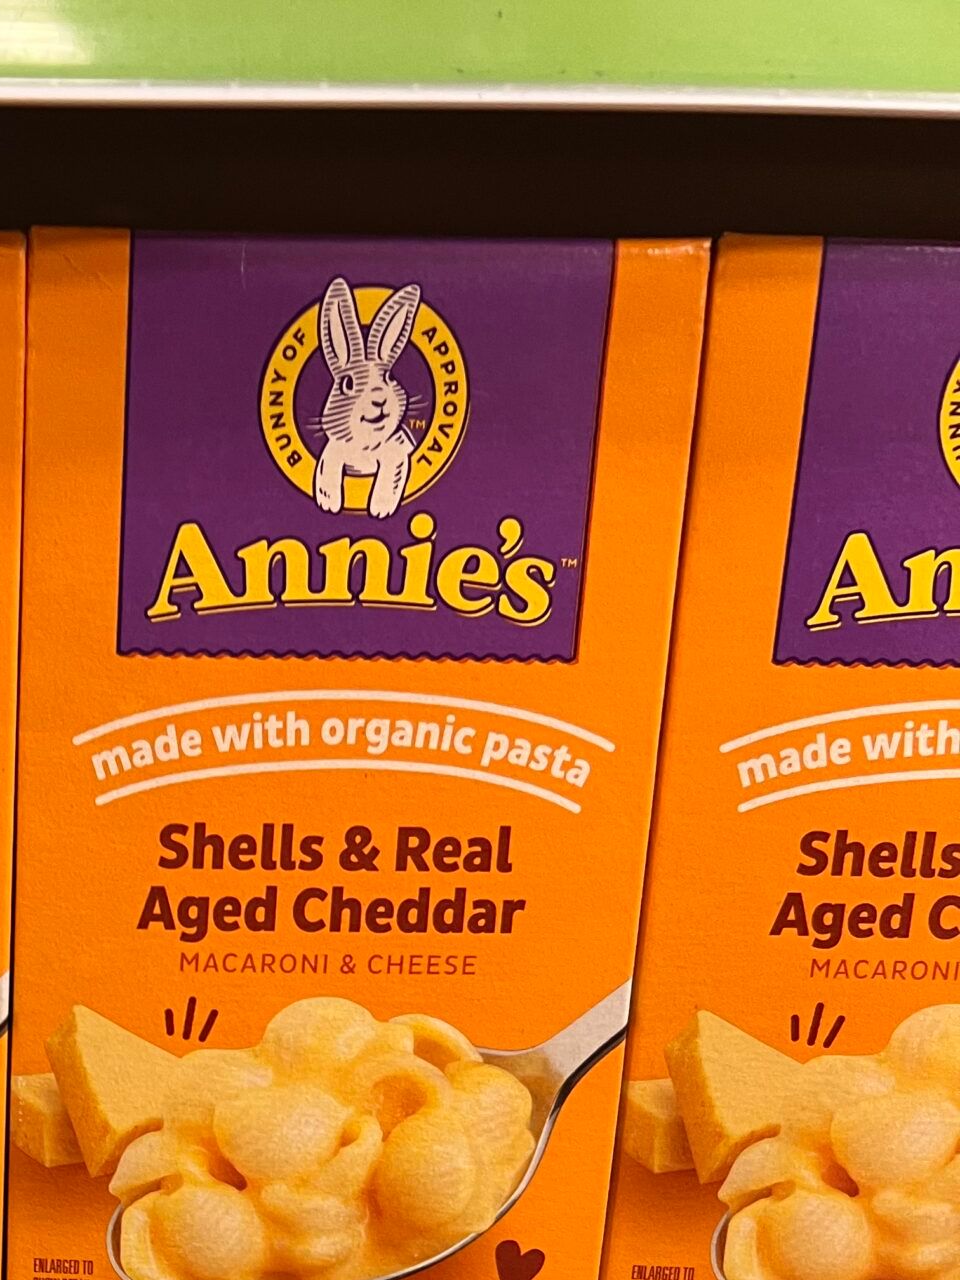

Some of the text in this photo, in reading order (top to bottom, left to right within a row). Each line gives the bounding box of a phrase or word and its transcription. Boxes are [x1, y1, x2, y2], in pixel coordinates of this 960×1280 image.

[270, 325, 458, 469] BUNNY OF APPROVAL
[145, 514, 556, 627] Annie's
[91, 712, 592, 788] made with organic pasta
[158, 823, 512, 874] Shells & Real
[796, 830, 960, 879] Shells
[137, 885, 526, 943] Aged Cheddar
[769, 892, 915, 949] Aged
[179, 952, 477, 975] MACARONI & CHEESE
[33, 1257, 94, 1277] ENLARGED TO
